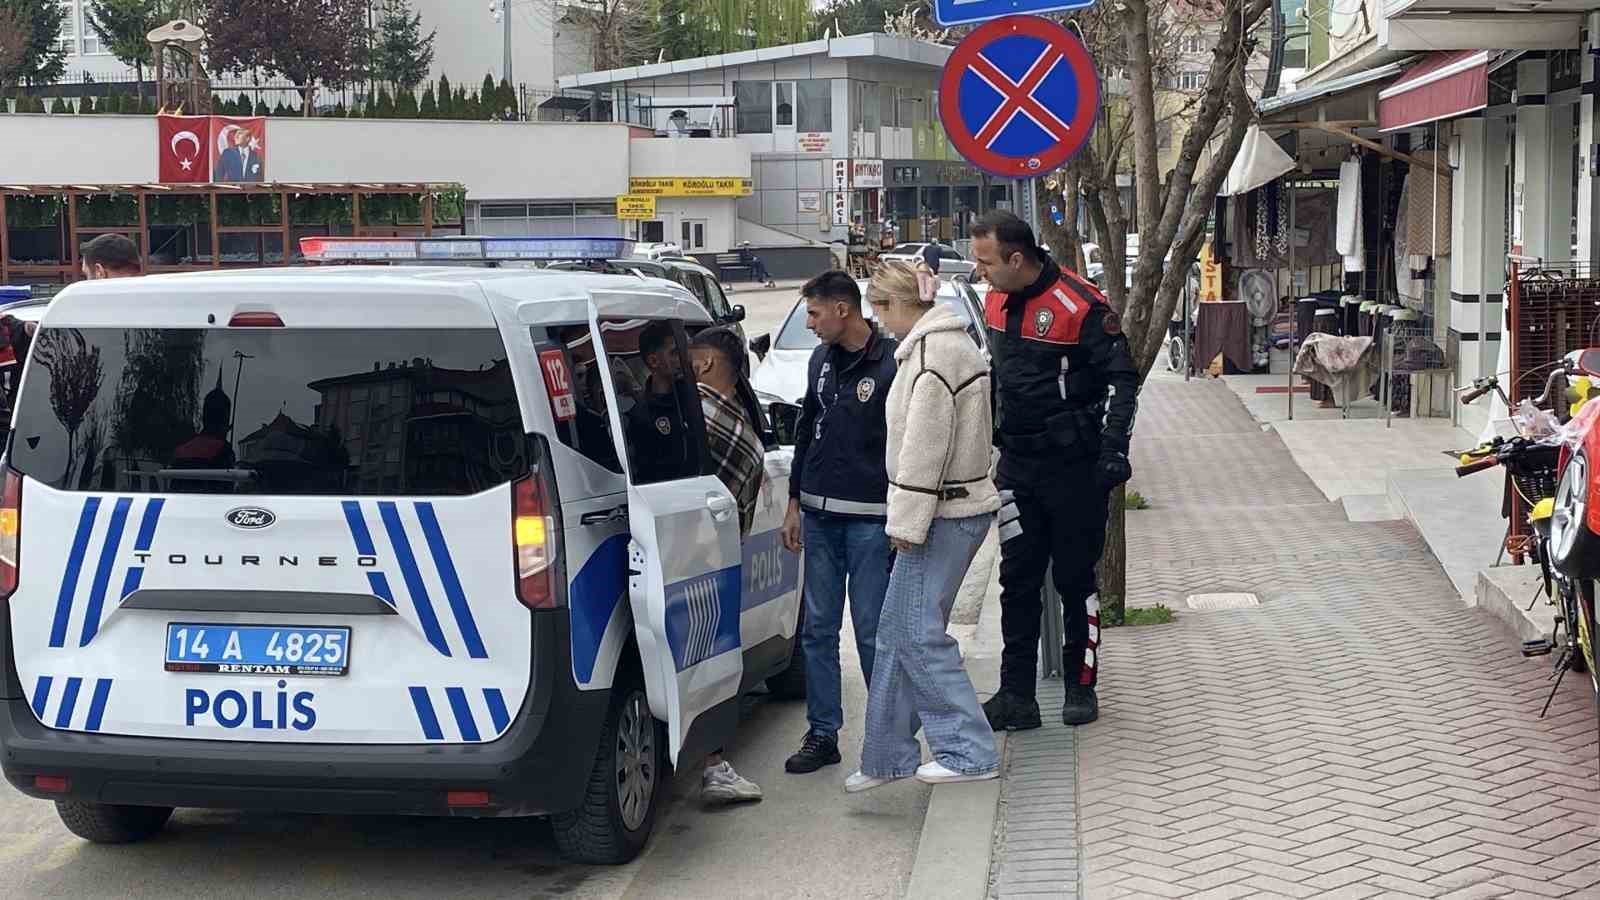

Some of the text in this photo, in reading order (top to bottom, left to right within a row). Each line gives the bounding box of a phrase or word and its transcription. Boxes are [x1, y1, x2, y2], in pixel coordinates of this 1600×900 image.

[546, 359, 569, 391] 112
[235, 510, 265, 524] Ford
[134, 553, 377, 567] TOURNEO
[176, 629, 343, 663] 14 A 4825
[218, 664, 291, 675] RENTAM
[186, 679, 317, 731] POLİS
